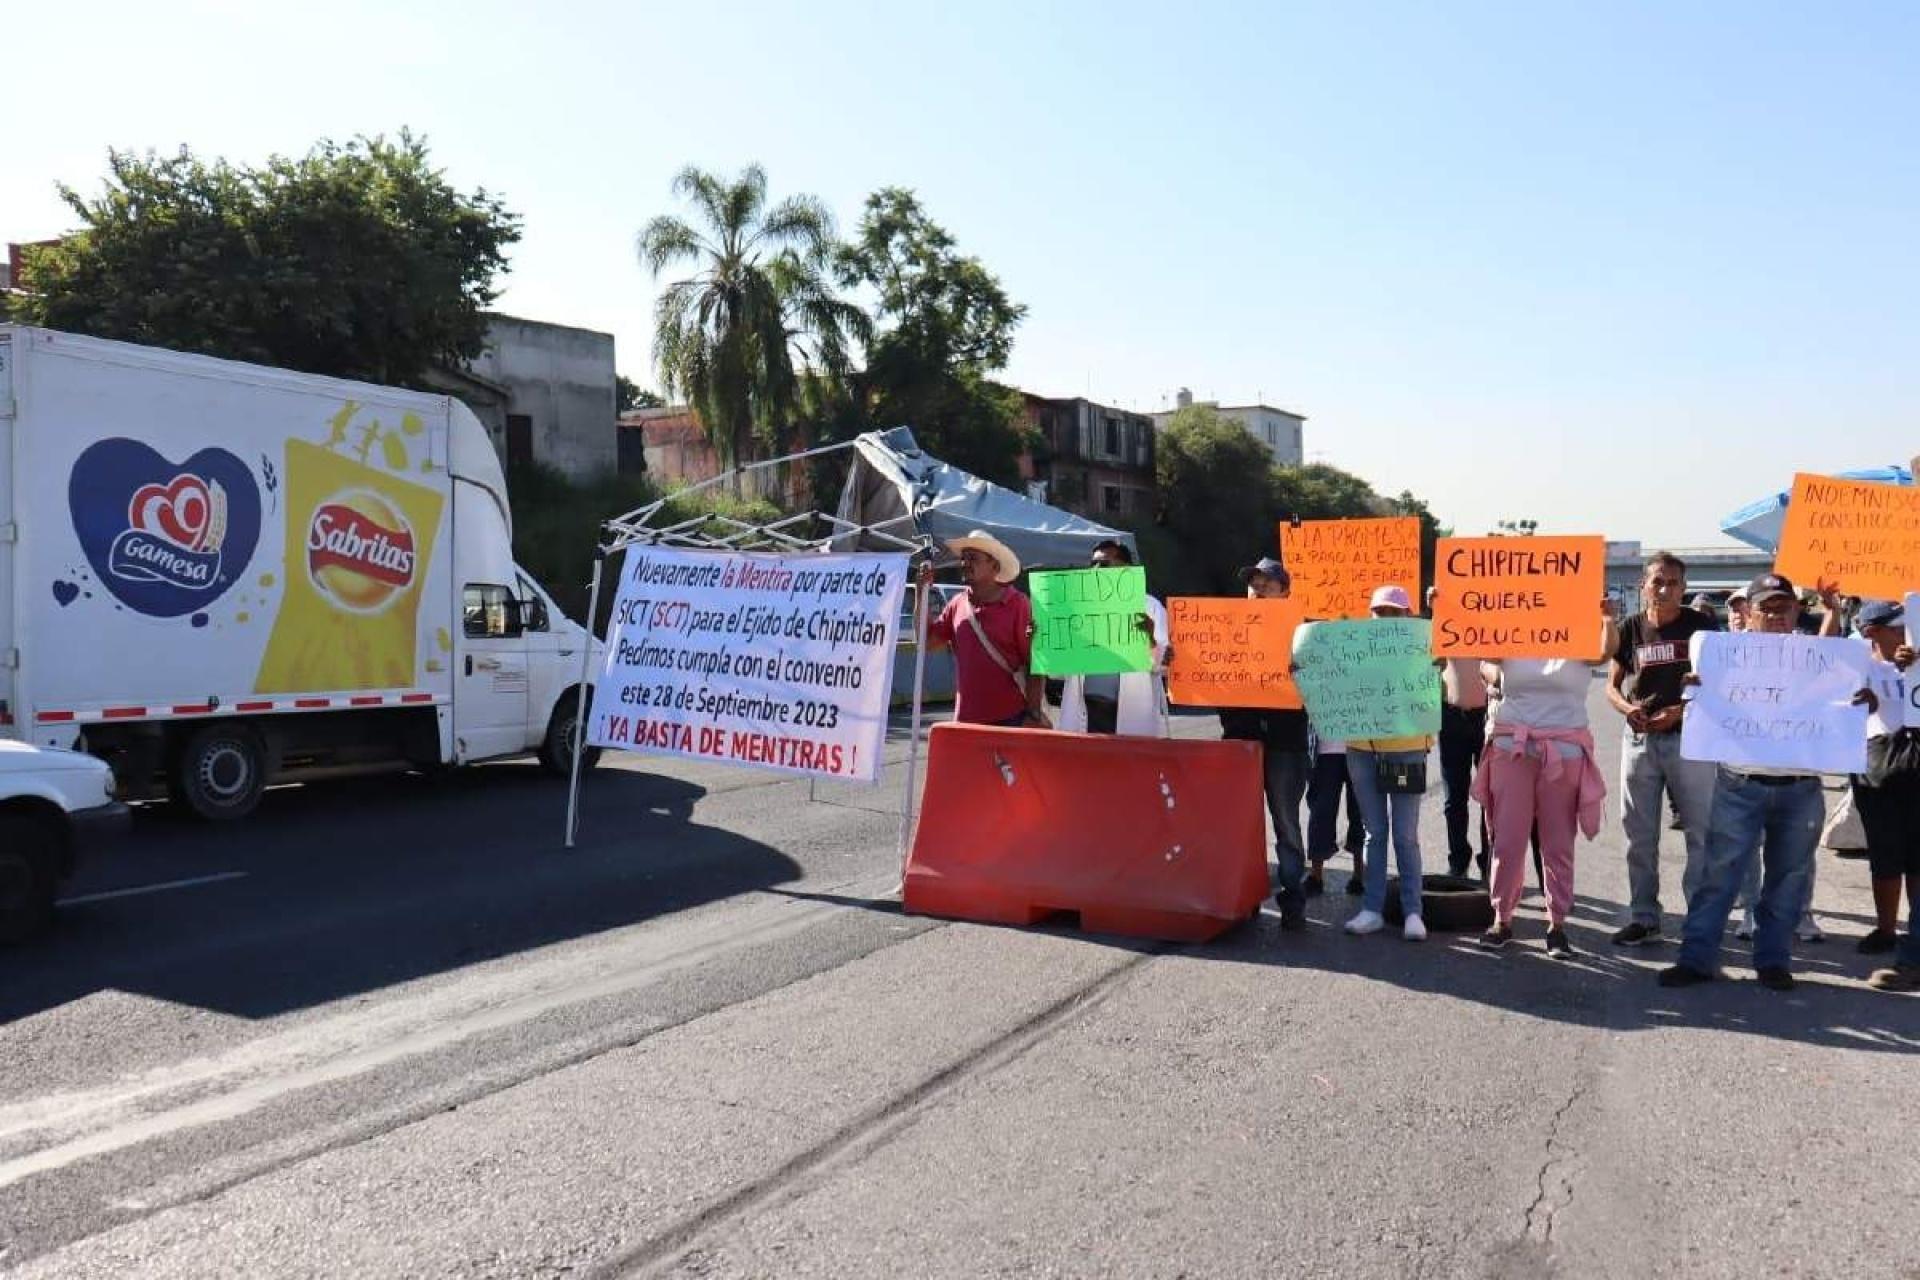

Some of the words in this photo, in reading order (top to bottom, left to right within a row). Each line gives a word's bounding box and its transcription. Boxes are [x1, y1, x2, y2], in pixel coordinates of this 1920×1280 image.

[124, 535, 209, 581] Gamesa
[310, 513, 413, 574] Sabritas
[1447, 548, 1582, 578] CHIPITLAN
[633, 555, 720, 589] Nuevamente
[720, 559, 735, 589] la
[736, 560, 793, 593] Mentira
[790, 570, 823, 602] por
[817, 568, 863, 602] parte
[865, 563, 886, 597] de
[617, 598, 651, 626] SICT
[647, 600, 691, 634] (SCT)
[686, 607, 724, 640] para
[725, 604, 744, 633] el
[741, 603, 782, 644] Ejido
[783, 607, 805, 639] de
[807, 607, 887, 652] Chipitlan
[1461, 591, 1547, 613] QUIERE
[1441, 618, 1570, 648] SOLUCION
[616, 638, 676, 668] Pedimos
[677, 645, 733, 682] cumpla
[734, 653, 763, 679] con
[766, 648, 784, 681] el
[785, 655, 862, 689] convenio
[620, 683, 651, 706] este
[652, 685, 674, 708] 28
[674, 683, 695, 712] de
[695, 687, 790, 723] Septiembre
[793, 700, 840, 729] 2023
[633, 718, 693, 754] BASTA
[699, 726, 727, 756] DE
[730, 730, 844, 774] MENTIRAS
